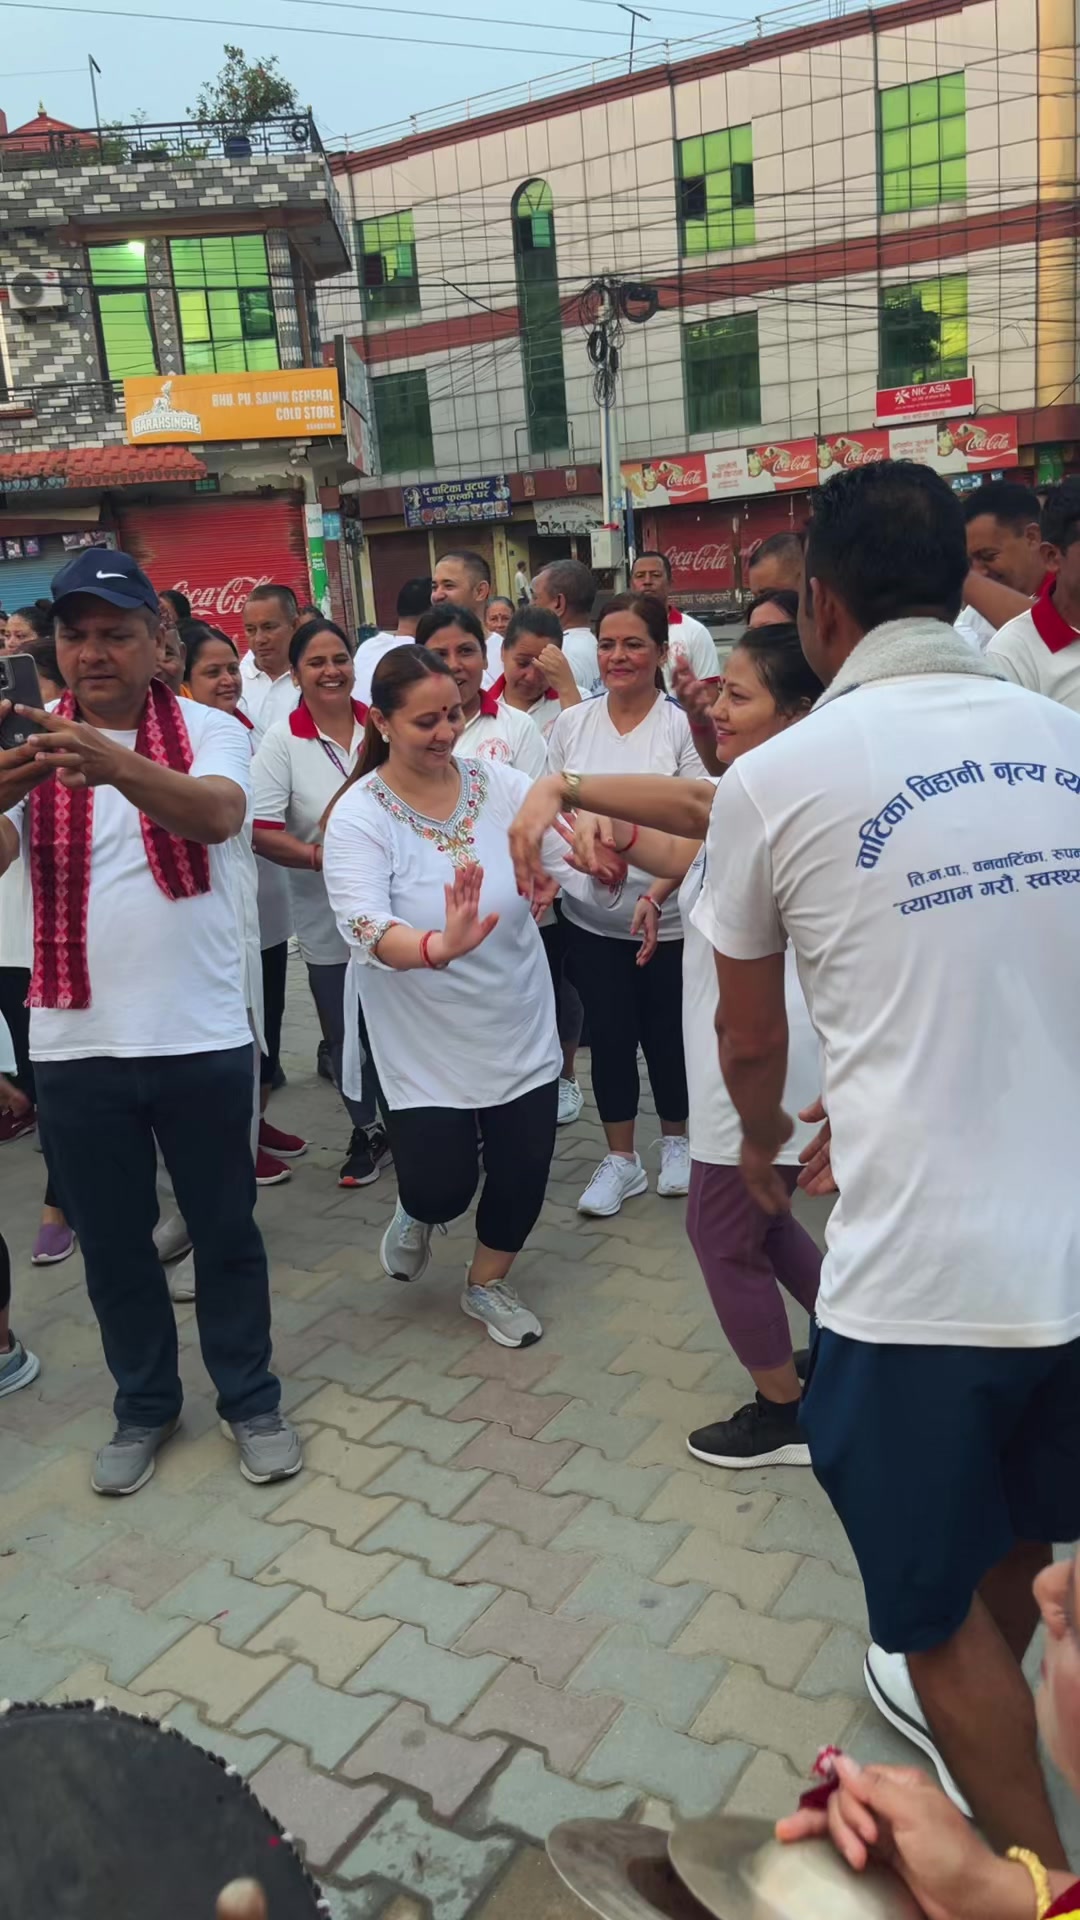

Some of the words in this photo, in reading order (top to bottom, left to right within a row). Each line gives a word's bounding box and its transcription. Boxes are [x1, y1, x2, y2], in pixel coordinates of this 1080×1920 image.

[291, 389, 334, 403] GENERAL
[911, 387, 927, 396] NIC
[929, 383, 951, 393] ASIA
[276, 406, 301, 421] COLD
[304, 405, 335, 419] STORE
[855, 792, 914, 870] वाटिका
[990, 762, 1048, 786] नृत्य
[893, 884, 974, 915] व्यायाम
